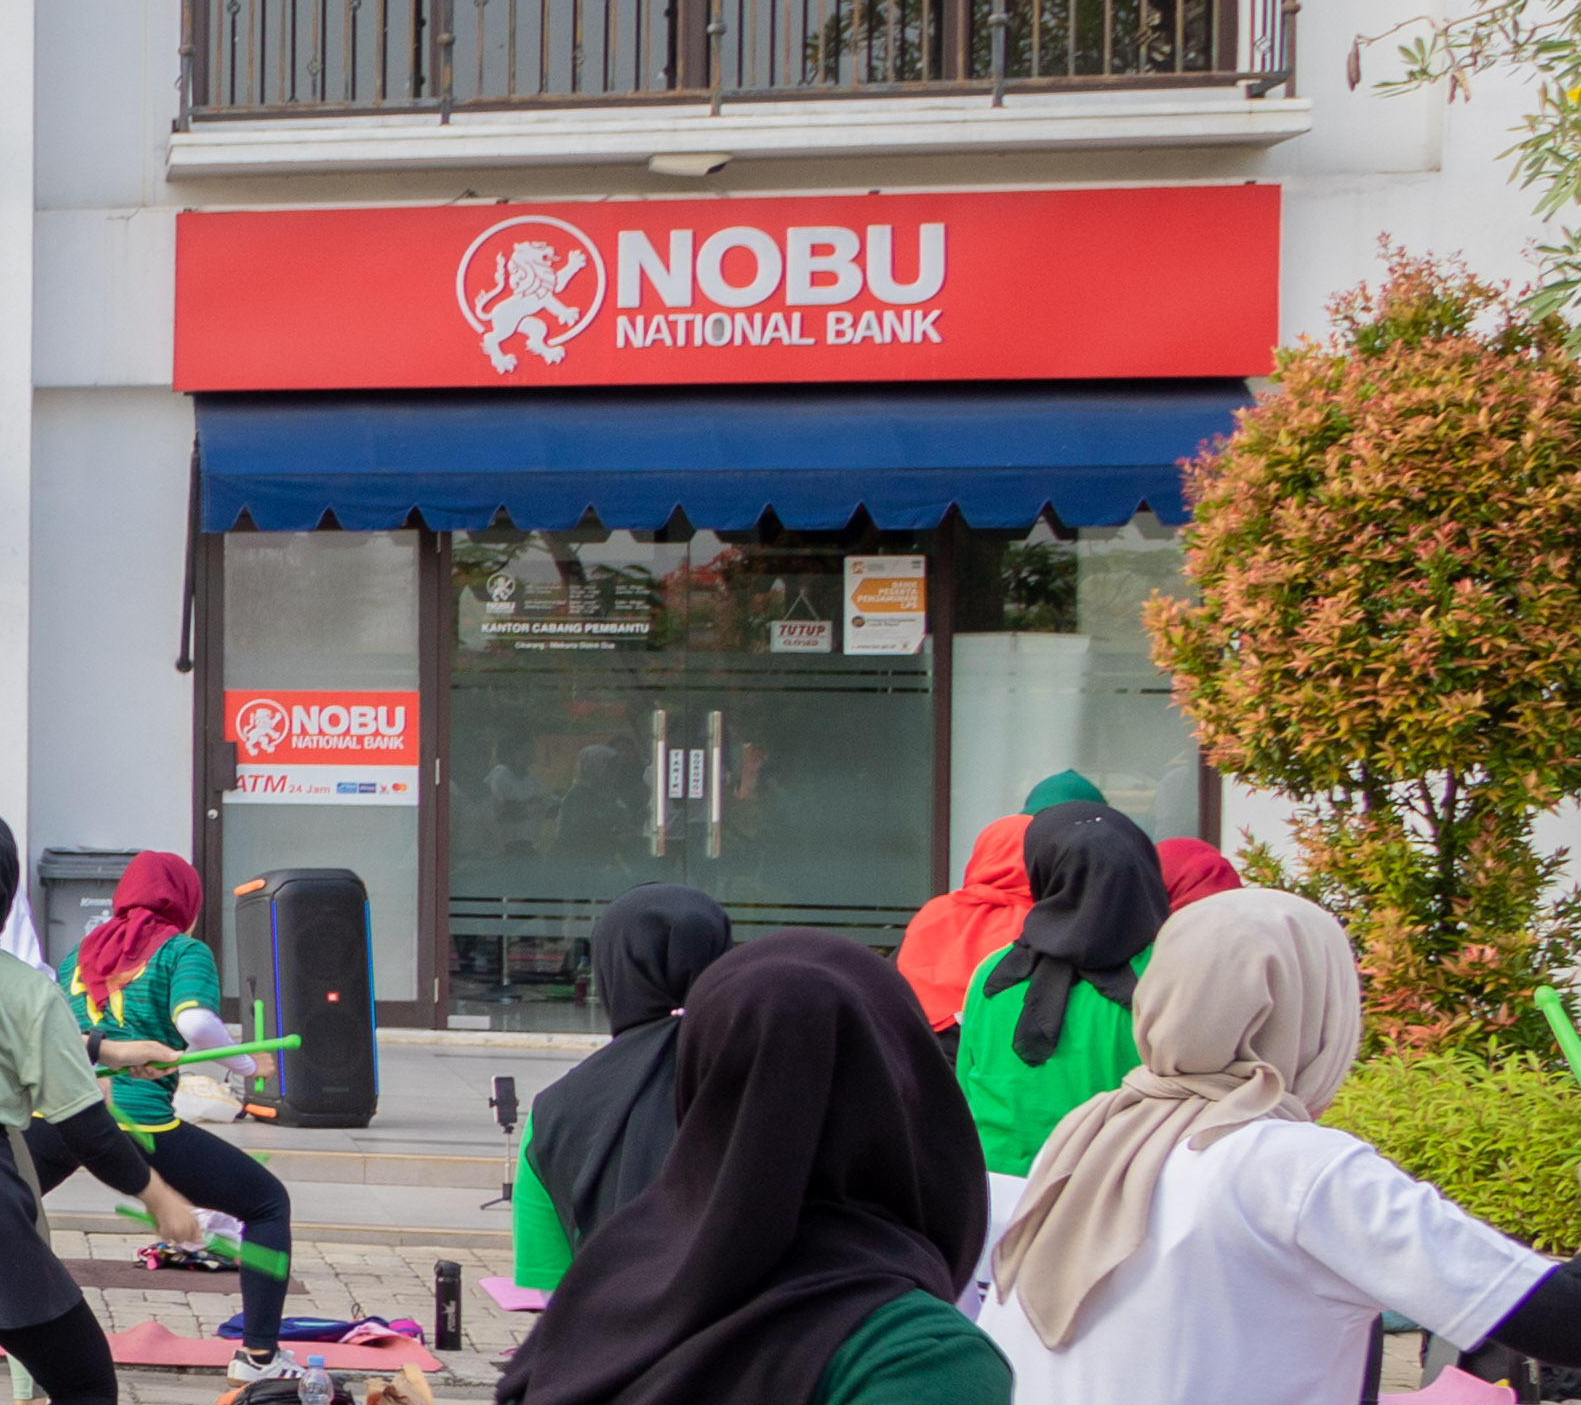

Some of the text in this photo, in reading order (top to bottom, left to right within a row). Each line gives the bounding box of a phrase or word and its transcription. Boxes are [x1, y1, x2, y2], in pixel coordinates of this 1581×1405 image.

[616, 222, 948, 309] NOBU
[616, 310, 943, 348] NATIONAL BANK
[481, 623, 650, 633] KANTOR CABANG PEMBANTU
[779, 624, 826, 636] TUTUP
[291, 705, 406, 735] NOBU
[291, 736, 404, 750] NATIONAL BANK
[236, 774, 288, 793] ATM
[289, 784, 302, 793] 24
[306, 784, 331, 794] Jam
